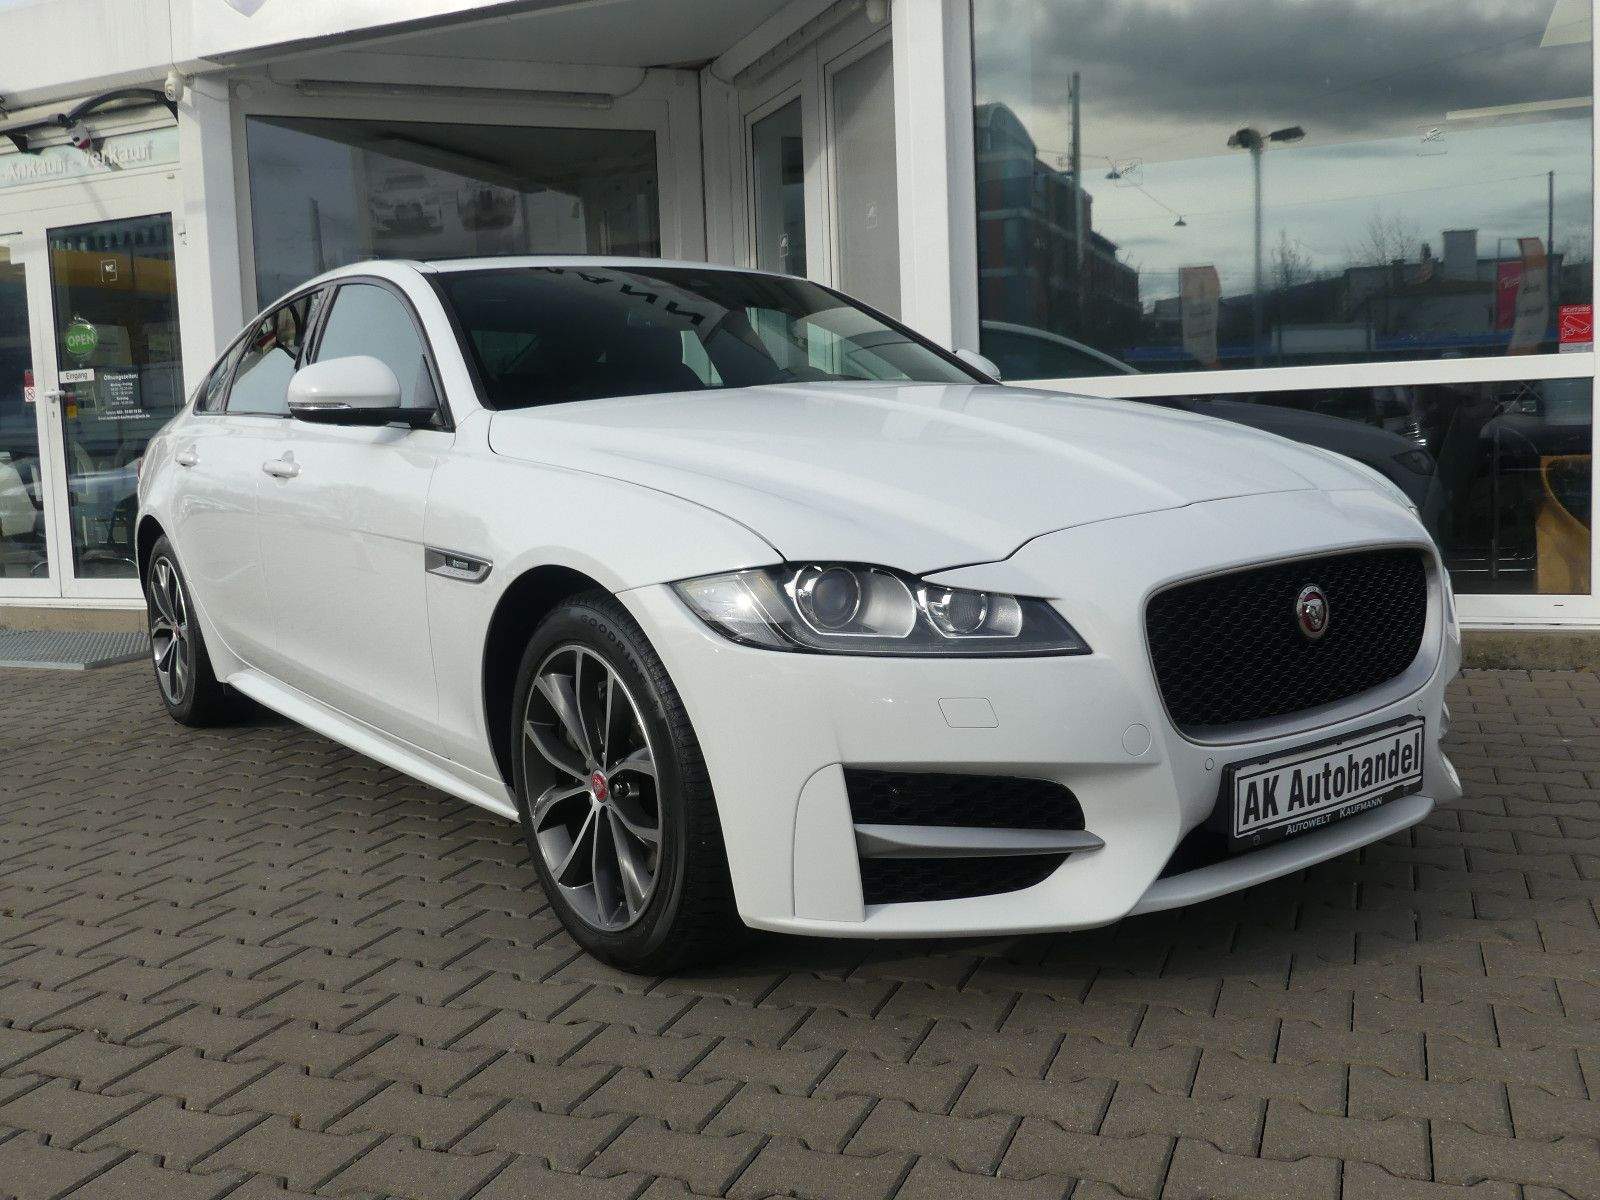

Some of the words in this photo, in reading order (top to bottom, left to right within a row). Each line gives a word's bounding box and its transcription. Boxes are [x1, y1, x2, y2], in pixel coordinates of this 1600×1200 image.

[68, 335, 96, 347] OPEN
[66, 372, 87, 380] Eingang
[1242, 774, 1280, 826] AK
[1287, 732, 1421, 812] Autohandel
[1285, 814, 1333, 836] AUTOWELT
[1339, 797, 1384, 819] KAUFMANN
